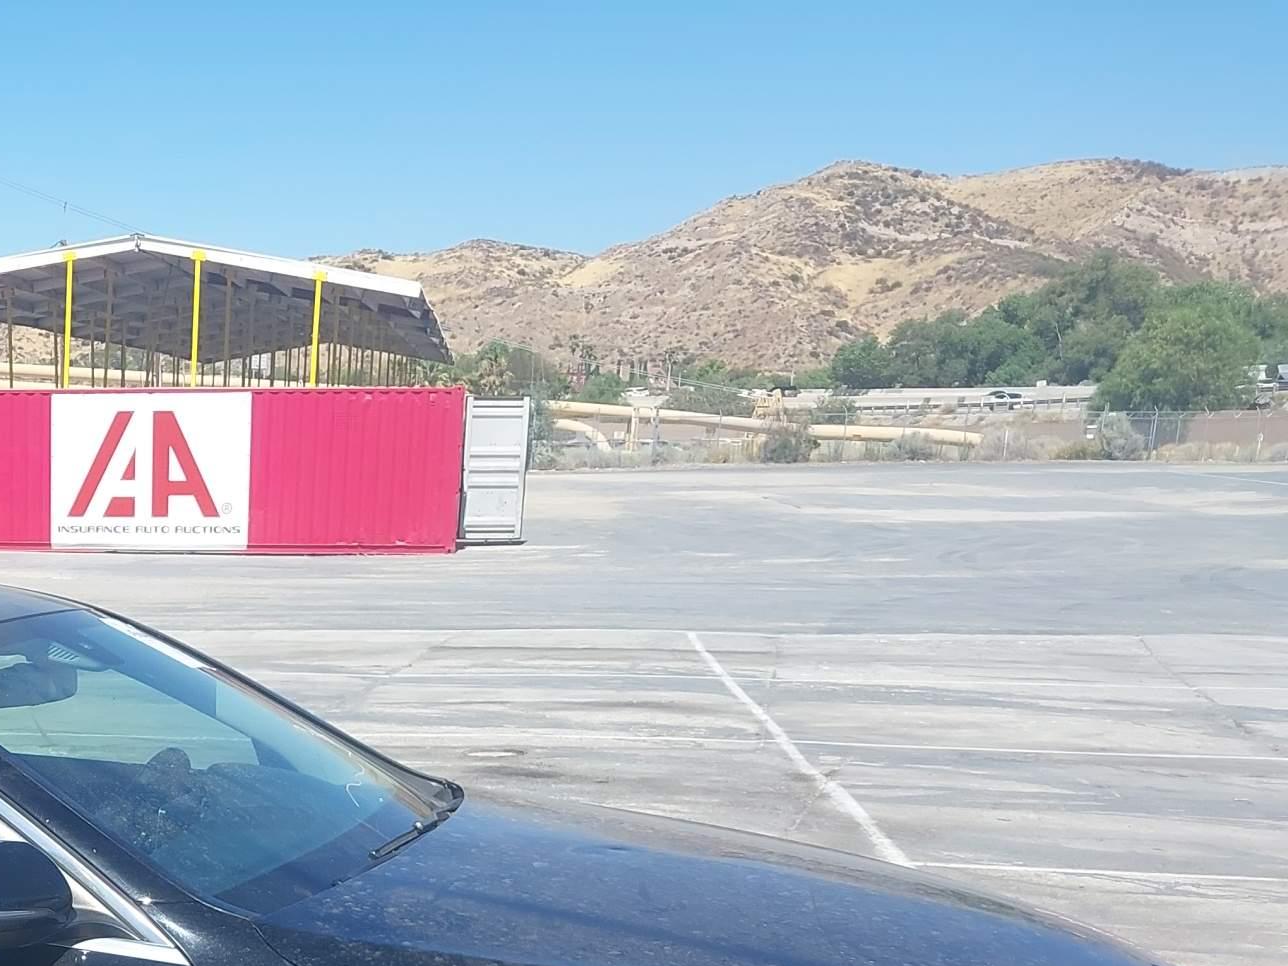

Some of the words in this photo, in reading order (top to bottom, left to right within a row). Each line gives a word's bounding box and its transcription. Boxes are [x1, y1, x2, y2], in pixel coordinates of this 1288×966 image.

[57, 525, 130, 534] INSURANCE
[135, 525, 170, 534] AUTO
[175, 525, 241, 534] AUCTIONS
